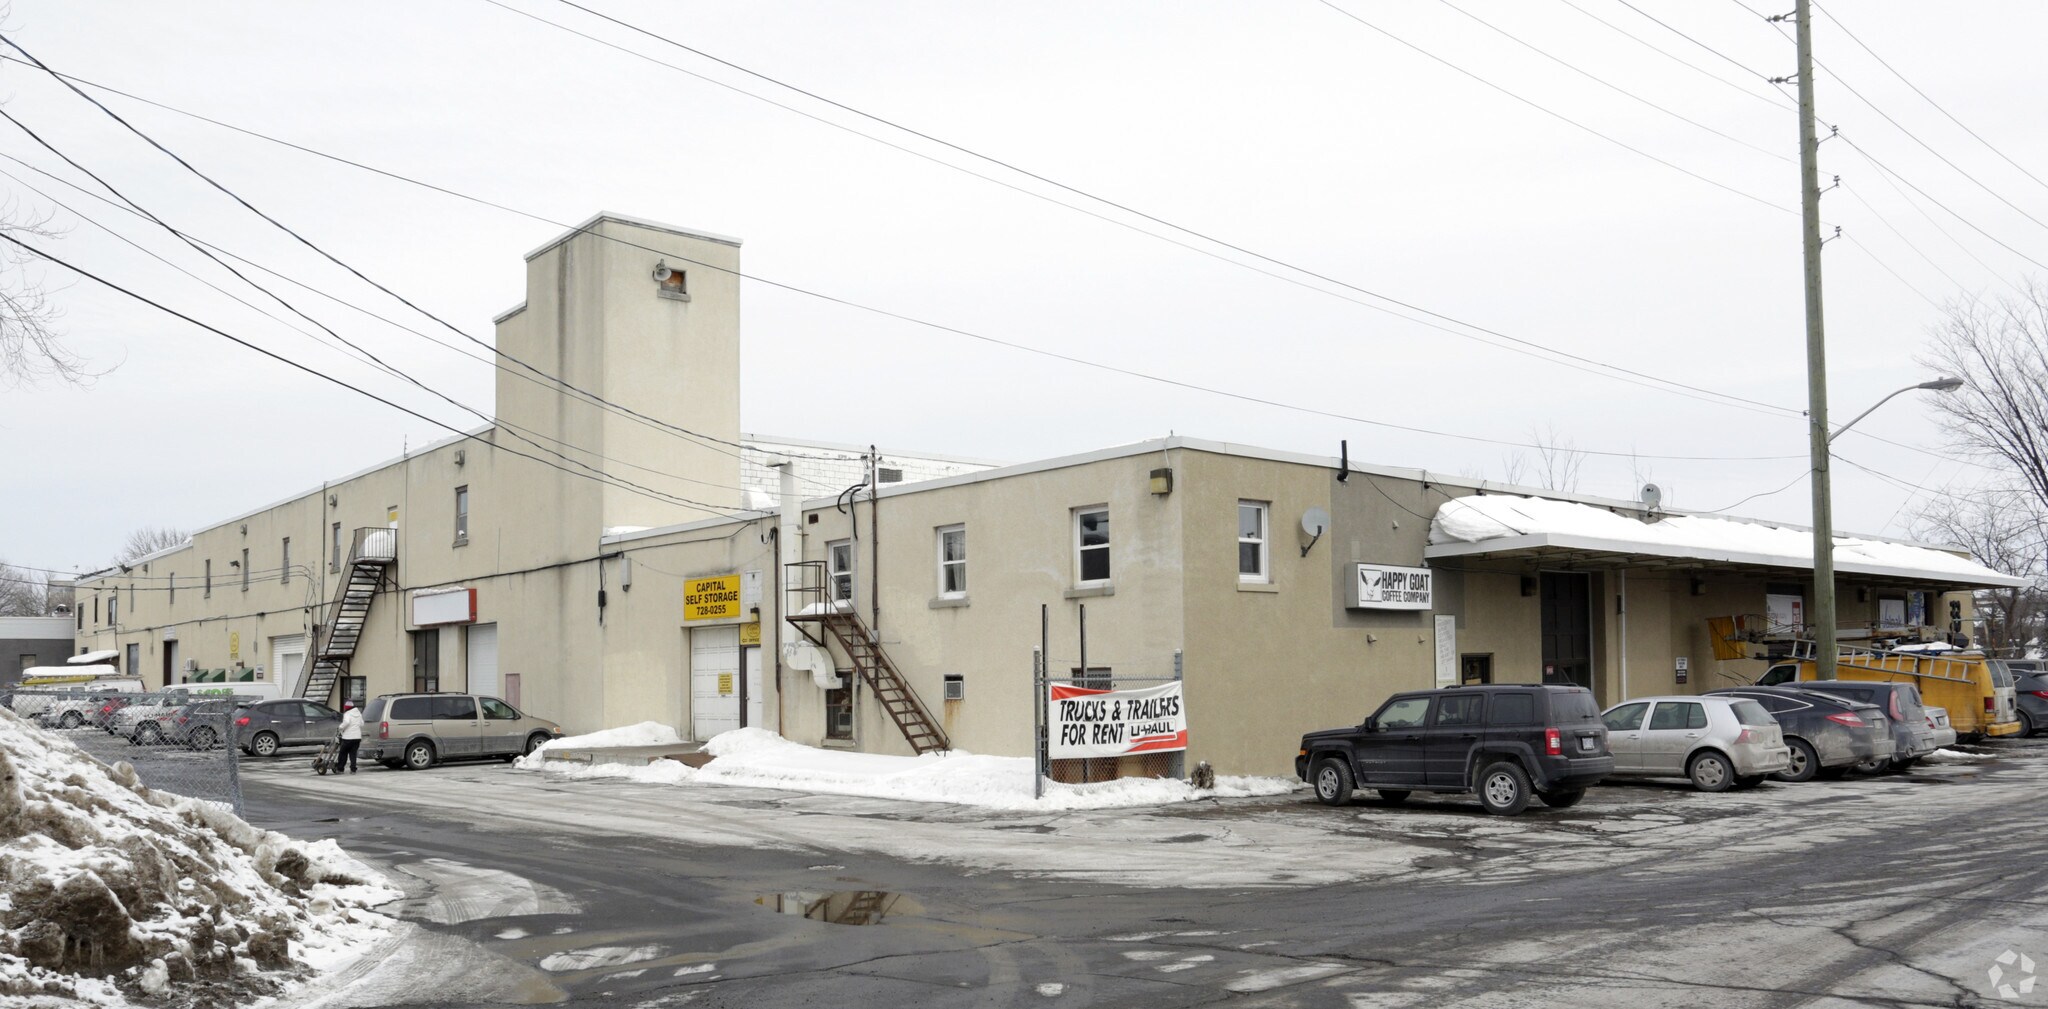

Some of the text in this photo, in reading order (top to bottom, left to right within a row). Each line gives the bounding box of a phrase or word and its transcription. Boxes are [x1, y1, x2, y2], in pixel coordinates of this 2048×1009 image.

[696, 581, 726, 593] CAPITAL
[1382, 571, 1430, 591] HAPPY GOAT
[686, 590, 738, 605] SELF STORAGE
[1382, 590, 1430, 603] COFFEE COMPANY
[696, 605, 727, 615] 728-0255
[1060, 695, 1179, 722] TRUCKS & TRAILERS
[1060, 723, 1125, 745] FOR RENT
[1130, 721, 1174, 737] U-HAUL
